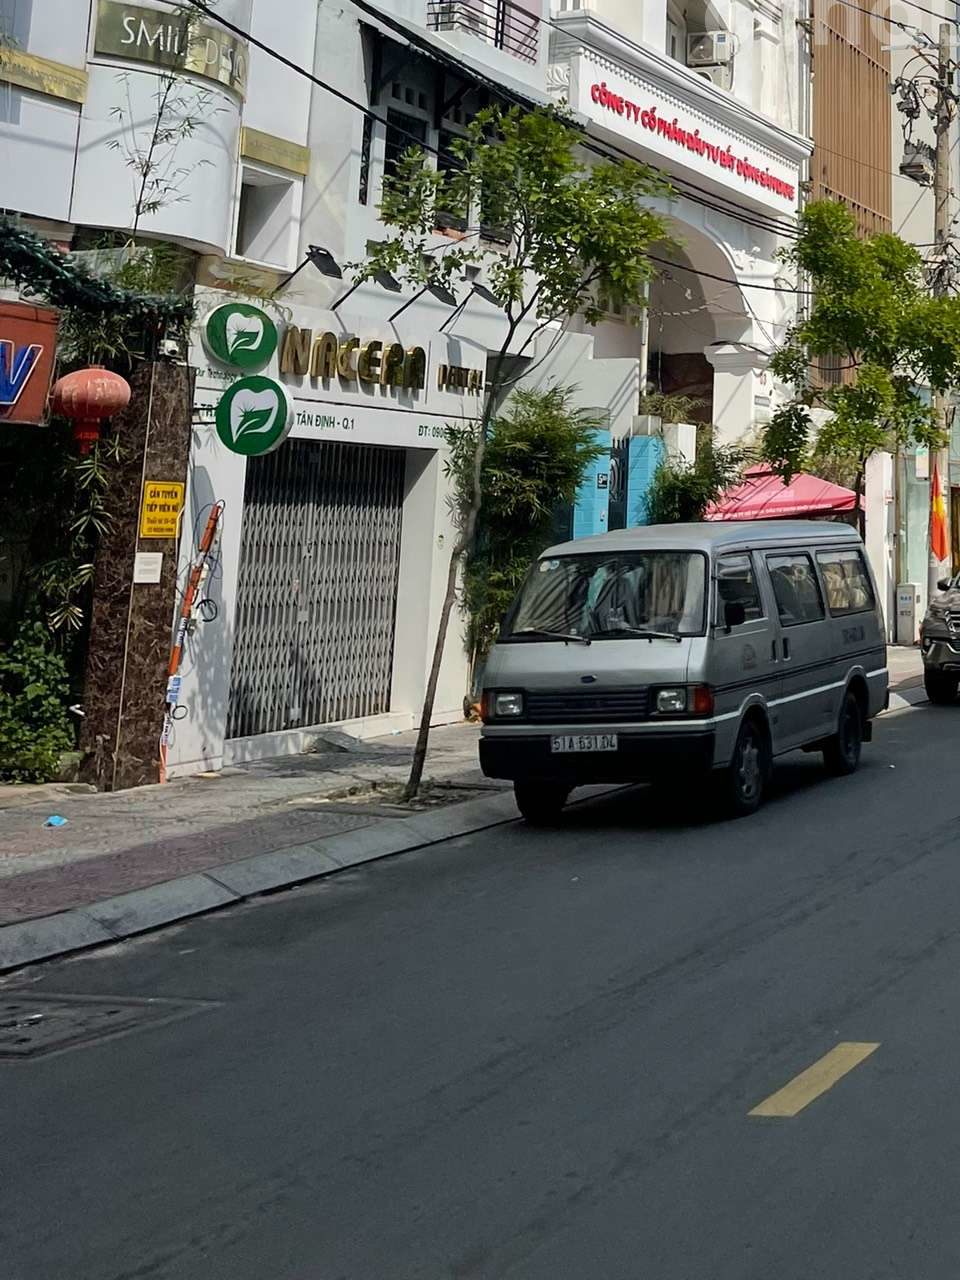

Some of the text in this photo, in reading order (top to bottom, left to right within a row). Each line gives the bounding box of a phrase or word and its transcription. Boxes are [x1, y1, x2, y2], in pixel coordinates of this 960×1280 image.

[591, 82, 624, 117] CÔNG
[624, 102, 640, 124] TY
[297, 410, 313, 425] TÂN
[314, 415, 335, 430] ĐỊNH
[342, 419, 355, 430] Q.1
